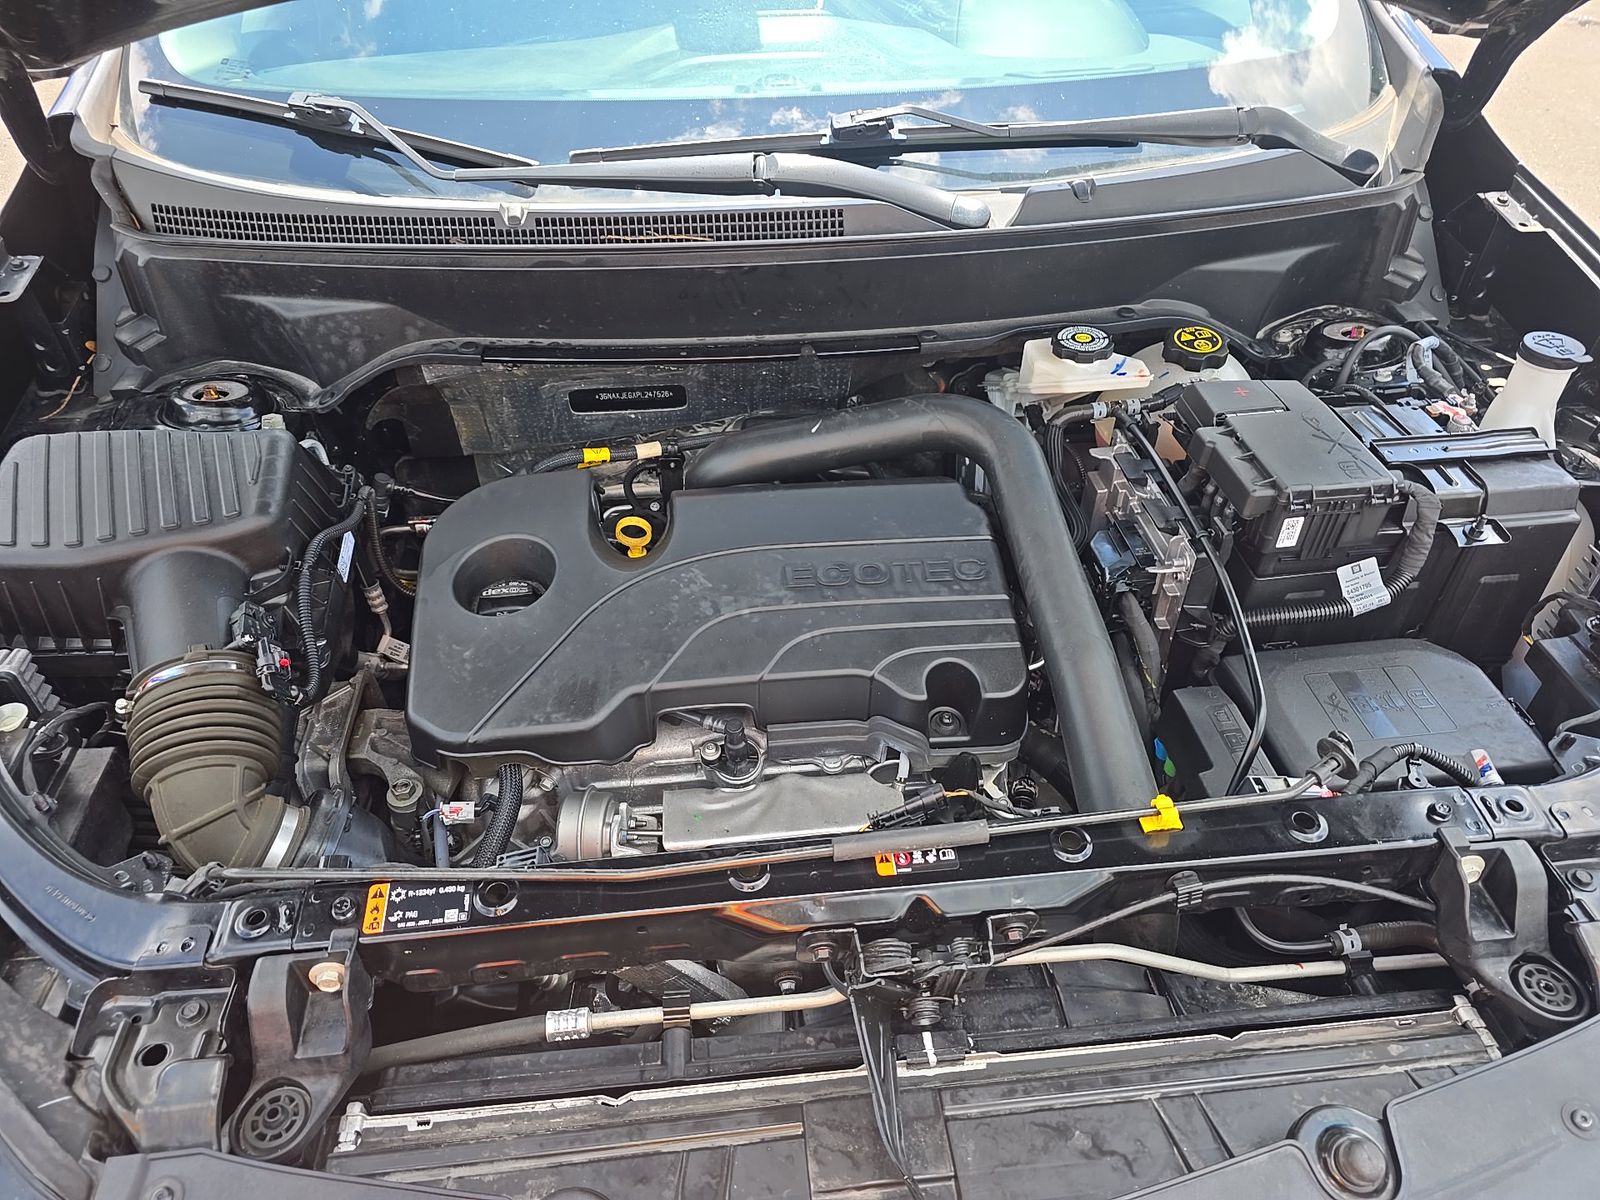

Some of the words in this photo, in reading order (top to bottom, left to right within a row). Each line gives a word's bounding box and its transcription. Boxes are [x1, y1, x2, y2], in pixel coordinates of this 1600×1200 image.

[783, 558, 986, 588] ECOTEC
[482, 586, 529, 596] dexos
[405, 911, 418, 919] PAG
